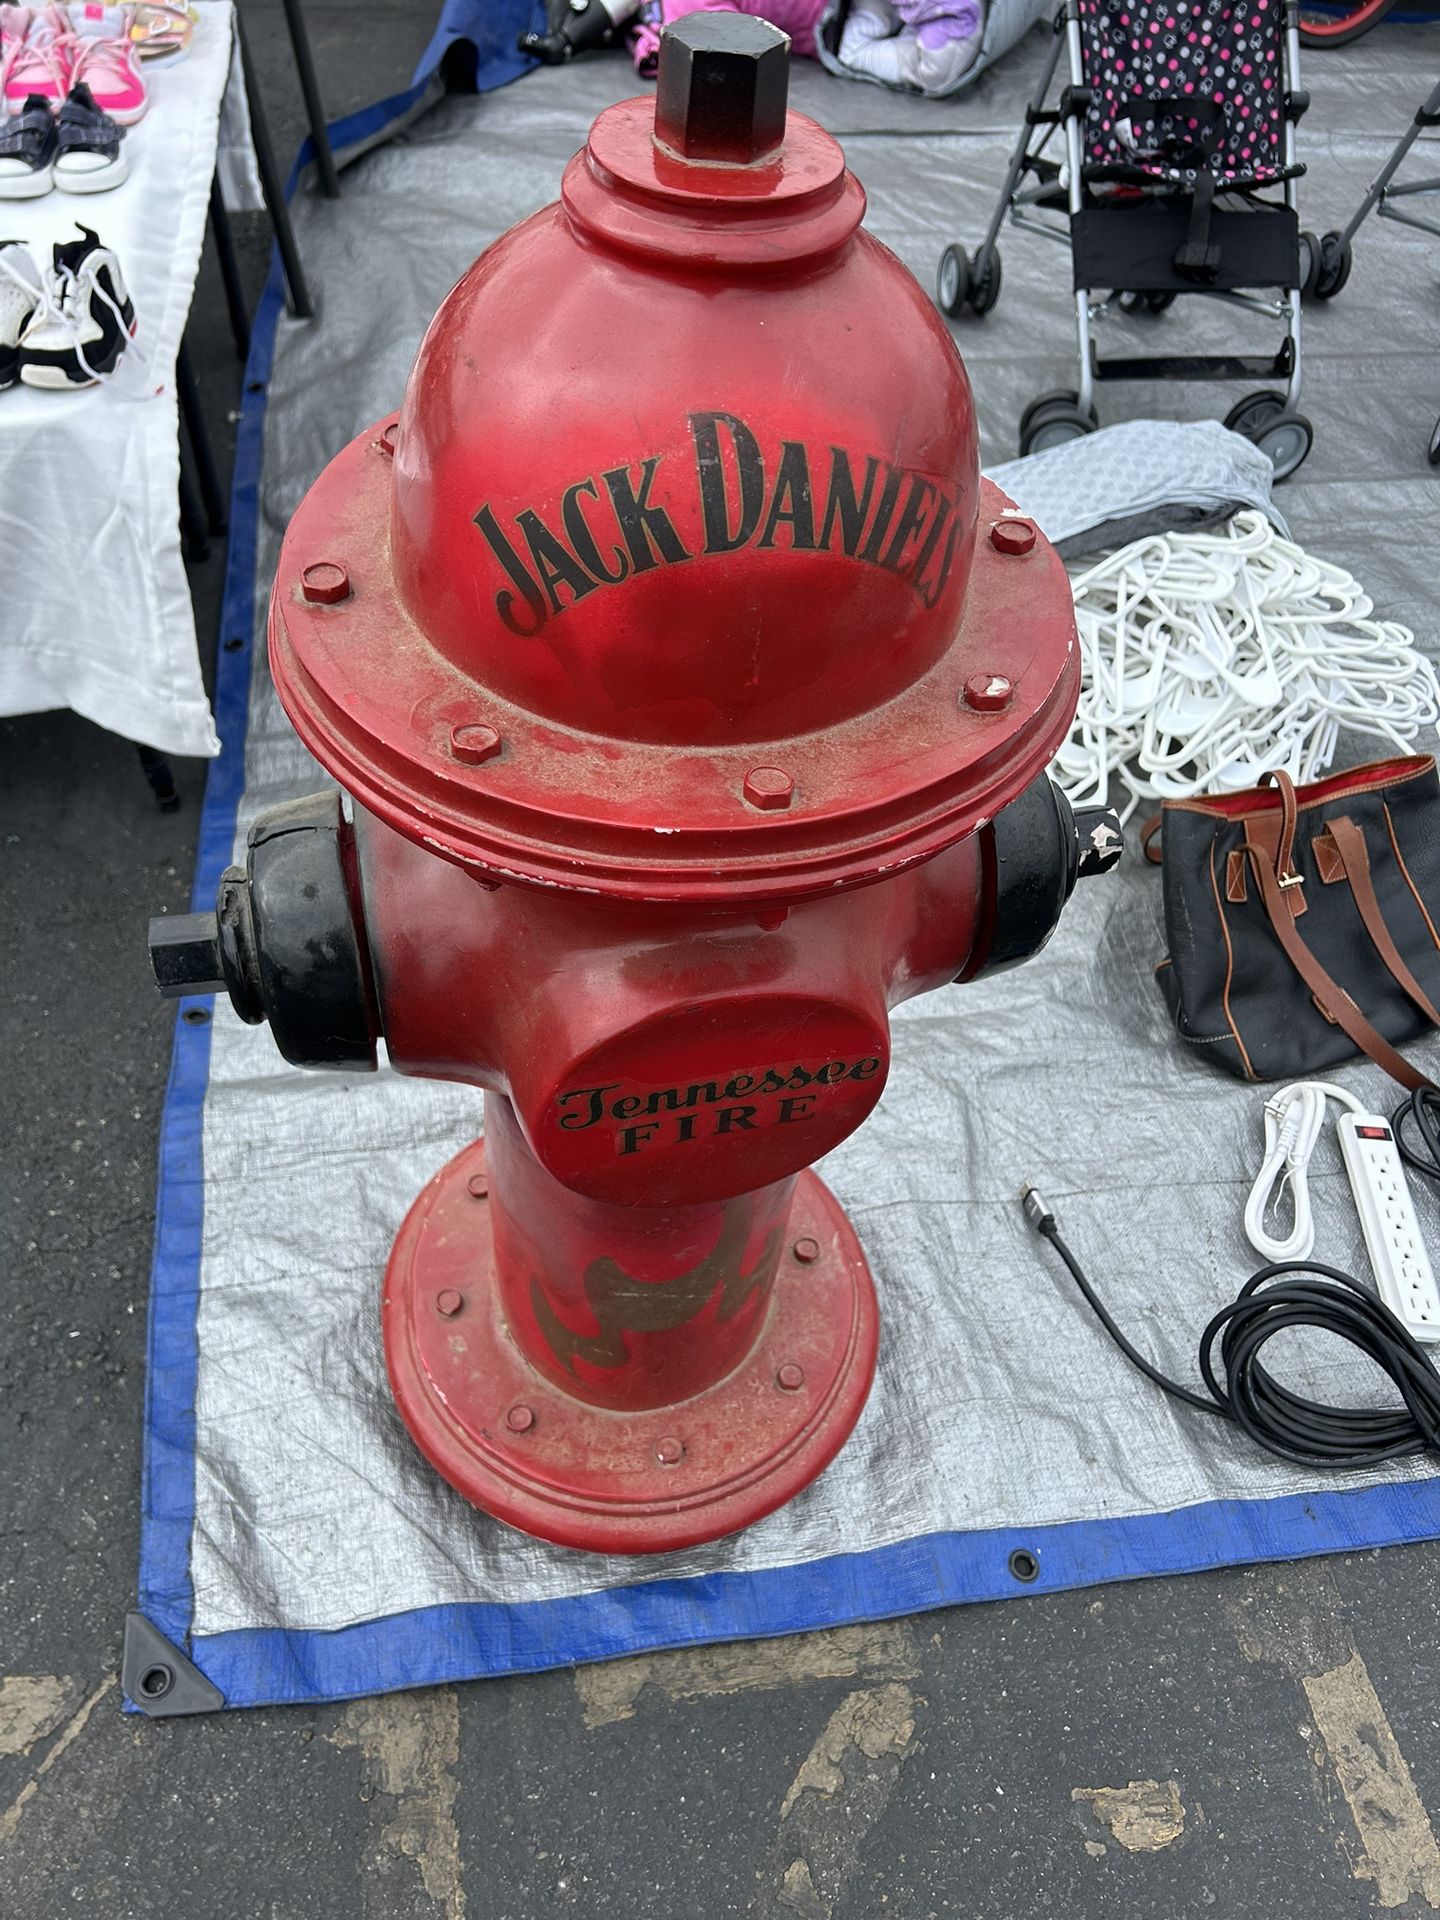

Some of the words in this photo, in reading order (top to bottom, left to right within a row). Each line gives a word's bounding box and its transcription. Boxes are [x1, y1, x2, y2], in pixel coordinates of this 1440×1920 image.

[473, 455, 693, 637] JACK
[558, 1056, 880, 1130] Tennessee
[618, 1095, 817, 1156] FIRE
